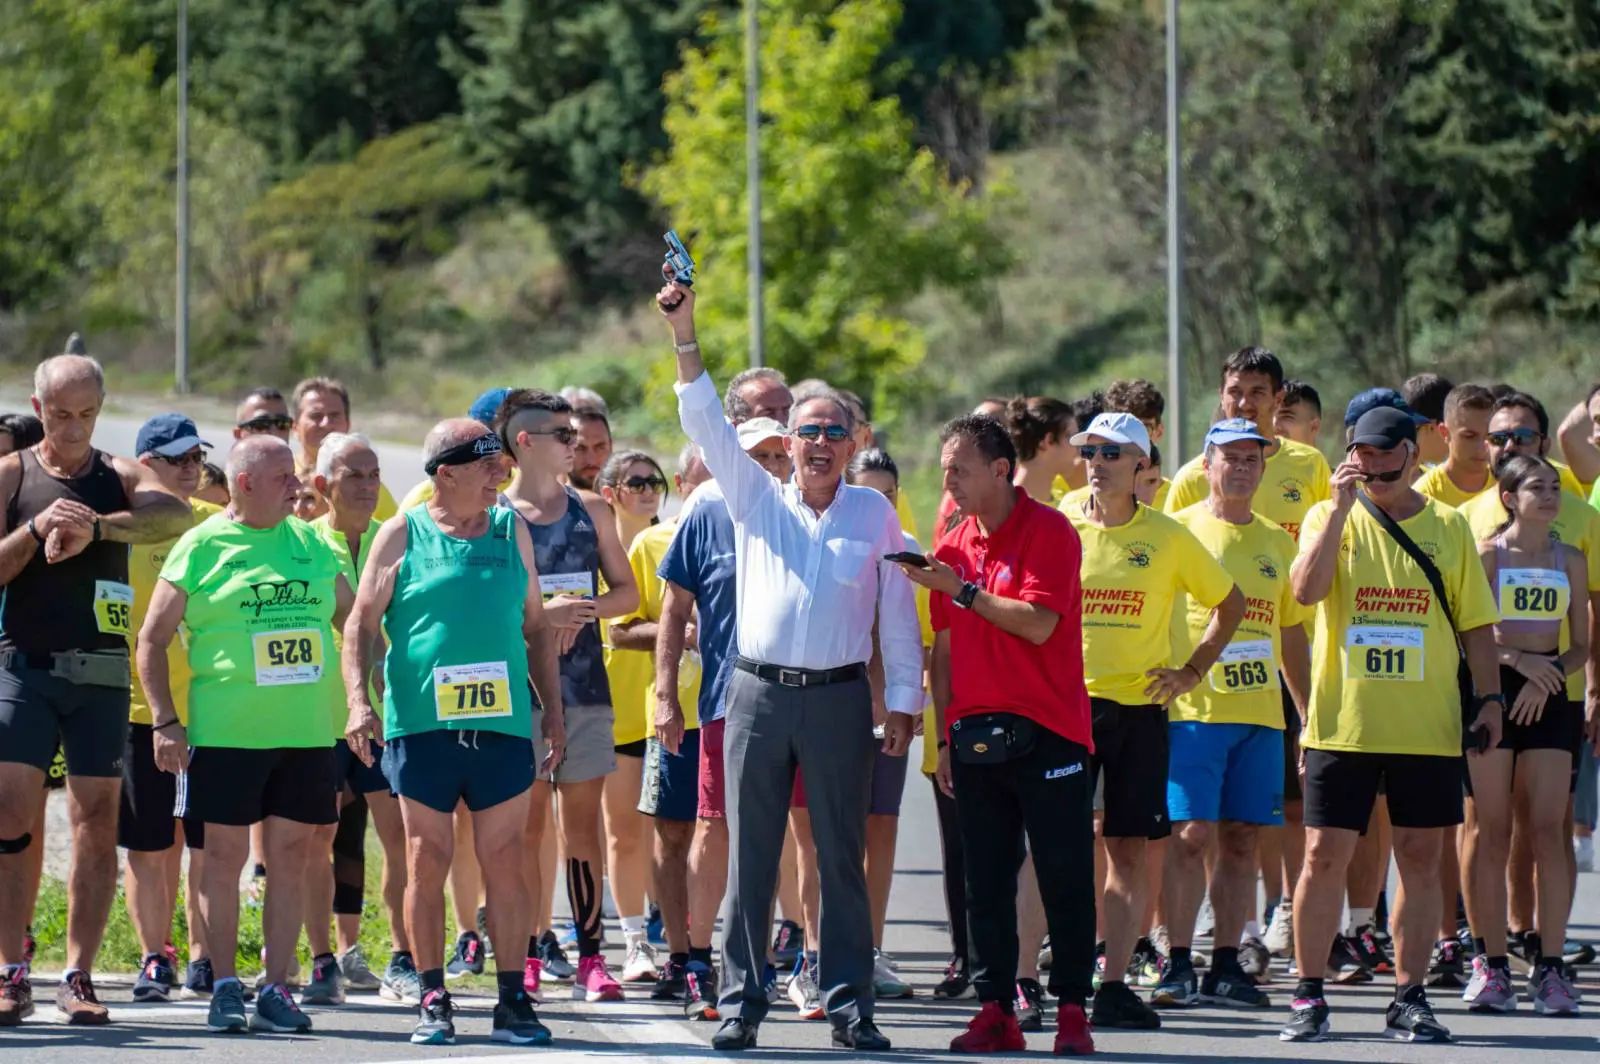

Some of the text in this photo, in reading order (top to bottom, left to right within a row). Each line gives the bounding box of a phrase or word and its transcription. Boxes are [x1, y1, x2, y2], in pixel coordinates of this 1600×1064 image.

[240, 586, 322, 617] myattica
[1080, 589, 1146, 602] ΝΗΜΕΣ
[1355, 586, 1430, 601] ΜΝΗΜΕΣ
[1514, 587, 1557, 612] 820
[1080, 600, 1145, 616] ΙΓΝΙΤΗ
[1355, 600, 1430, 615] ΛΙΓΝΙΤΗ
[267, 638, 313, 665] 825
[1366, 647, 1405, 674] 611
[1223, 660, 1268, 688] 563
[453, 681, 496, 710] 776
[1045, 762, 1083, 779] LEGEA
